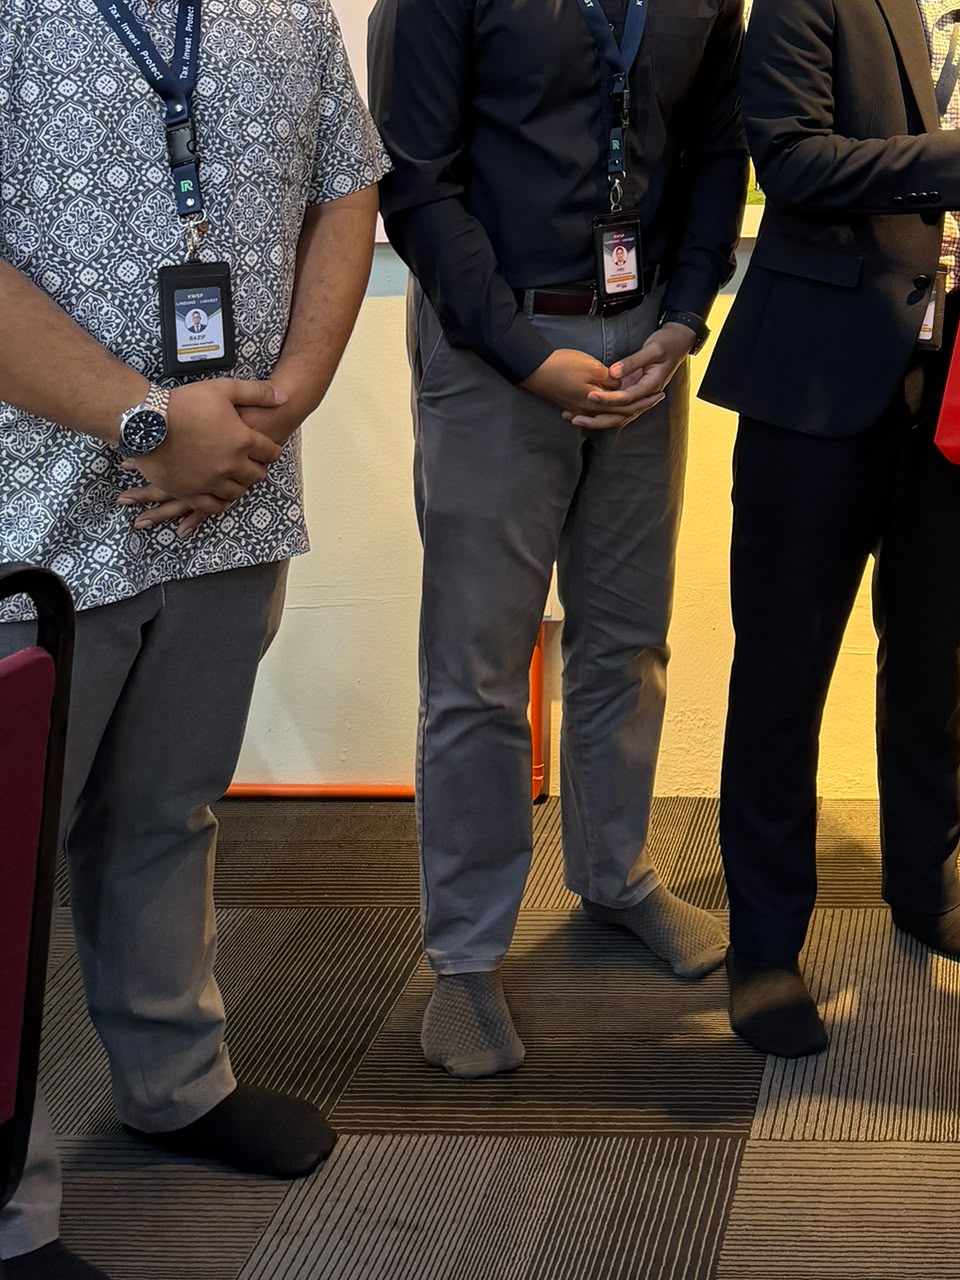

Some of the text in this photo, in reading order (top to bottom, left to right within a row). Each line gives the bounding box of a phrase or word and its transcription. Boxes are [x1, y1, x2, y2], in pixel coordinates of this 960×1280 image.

[108, 4, 163, 81] Tax Invest Protect
[180, 6, 195, 80] Tax Invest Protect
